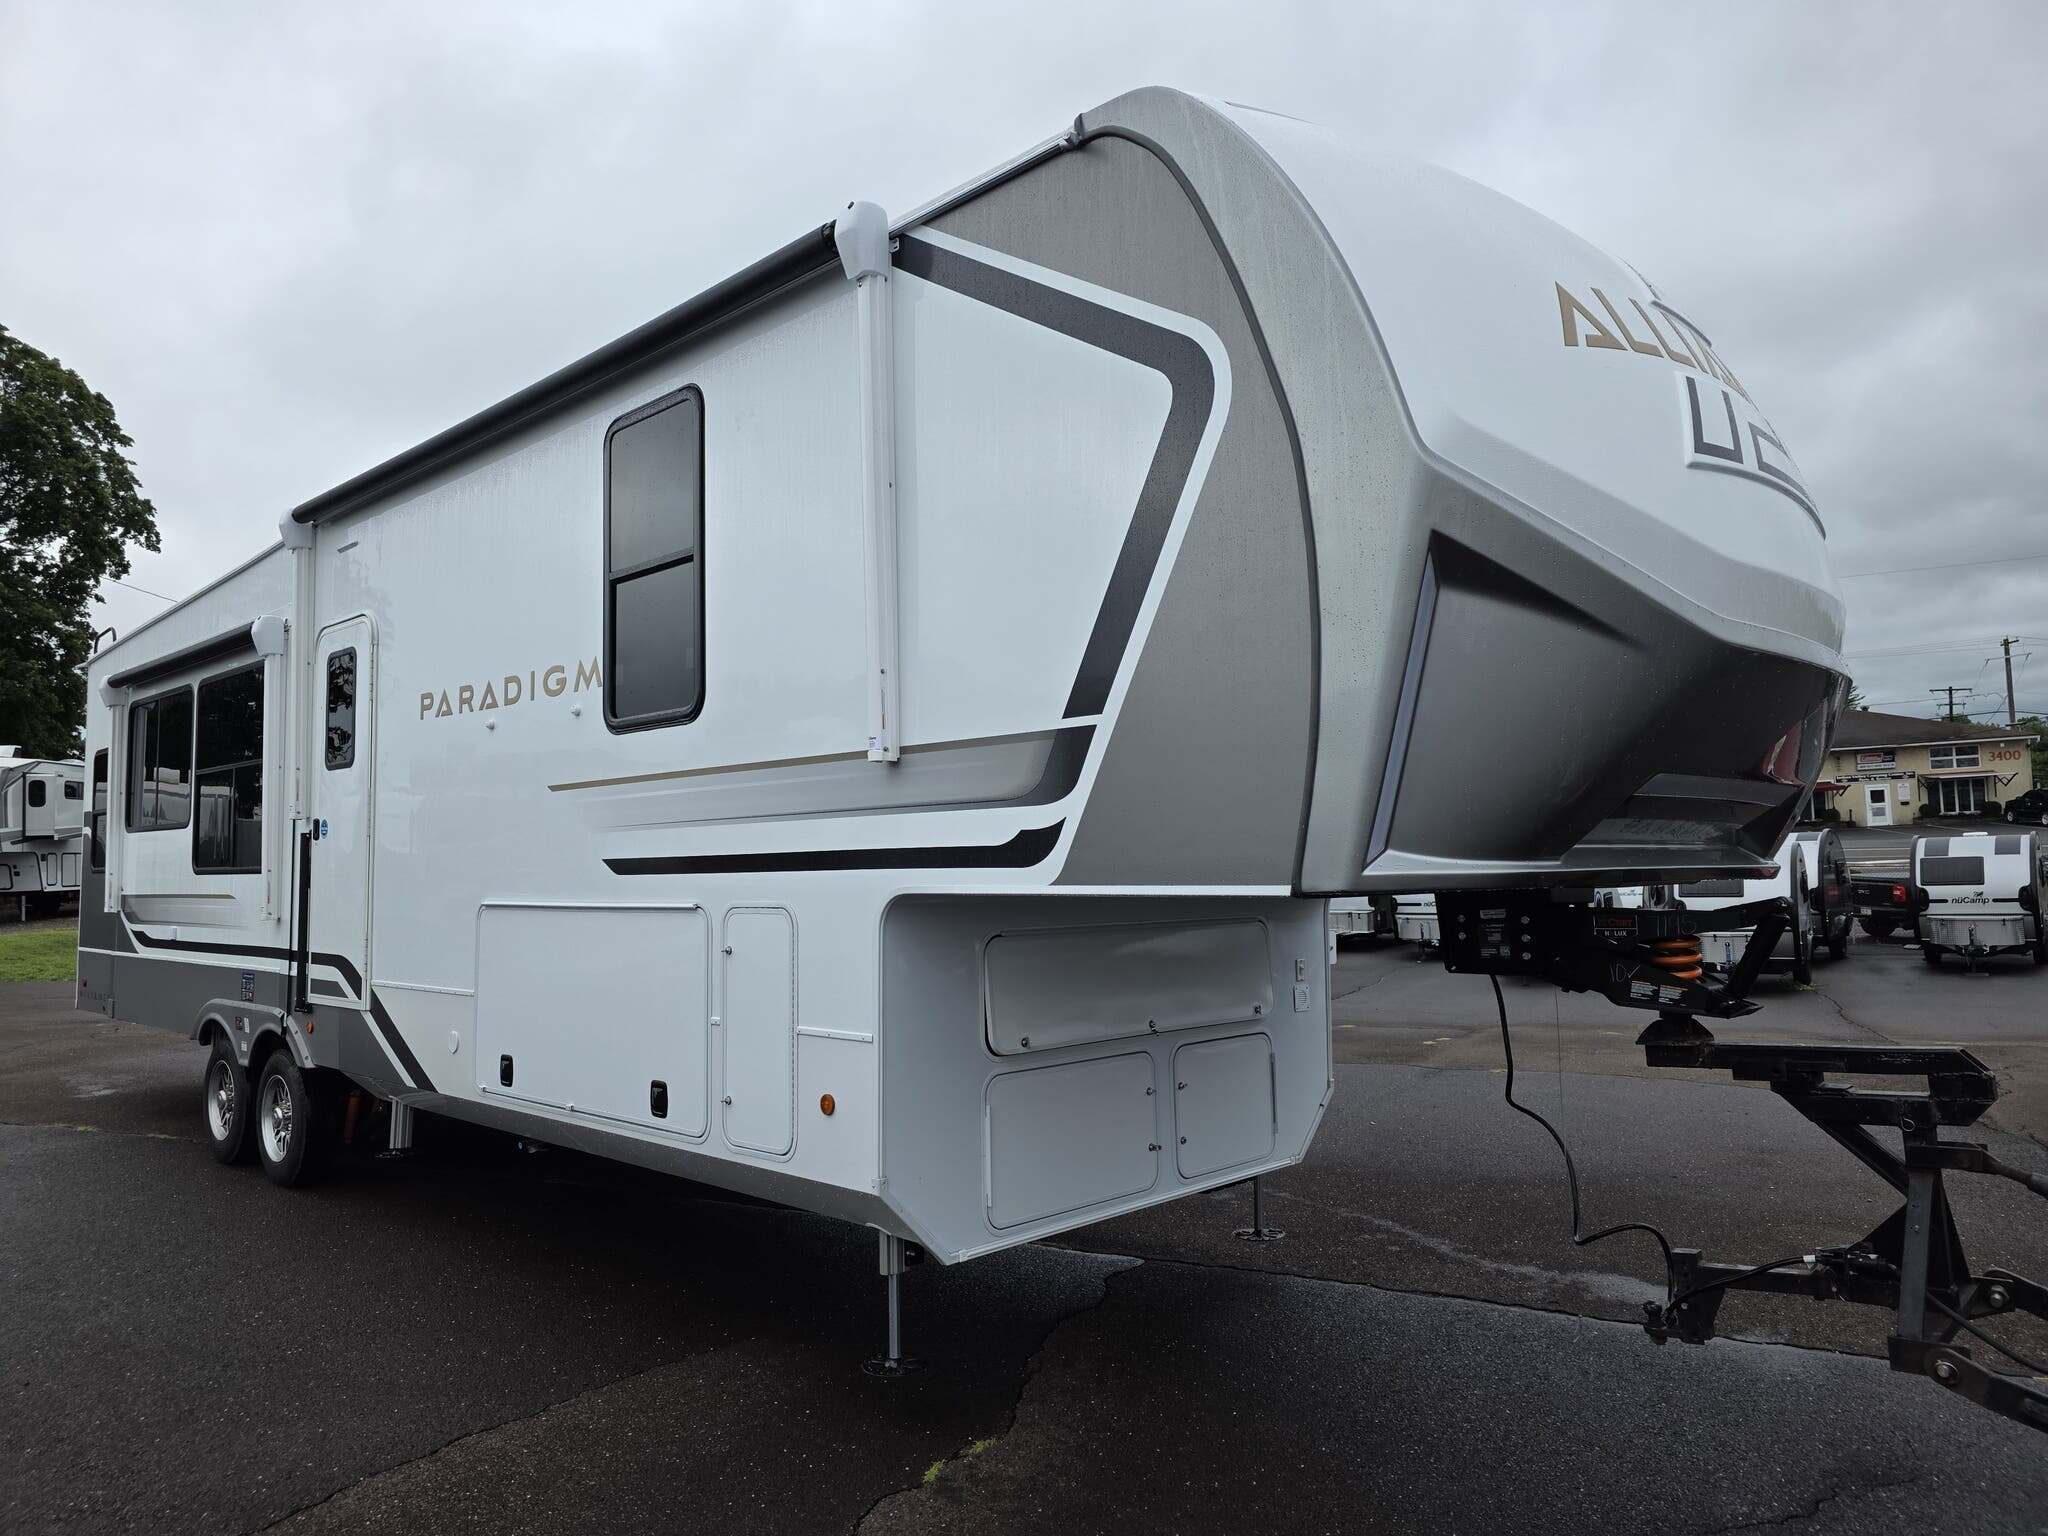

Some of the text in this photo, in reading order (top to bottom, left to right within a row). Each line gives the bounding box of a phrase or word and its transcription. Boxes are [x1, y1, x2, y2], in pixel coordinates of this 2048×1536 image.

[419, 655, 603, 721] PARADIGM
[1988, 750, 2021, 761] 3400
[1603, 929, 1628, 938] HLUX
